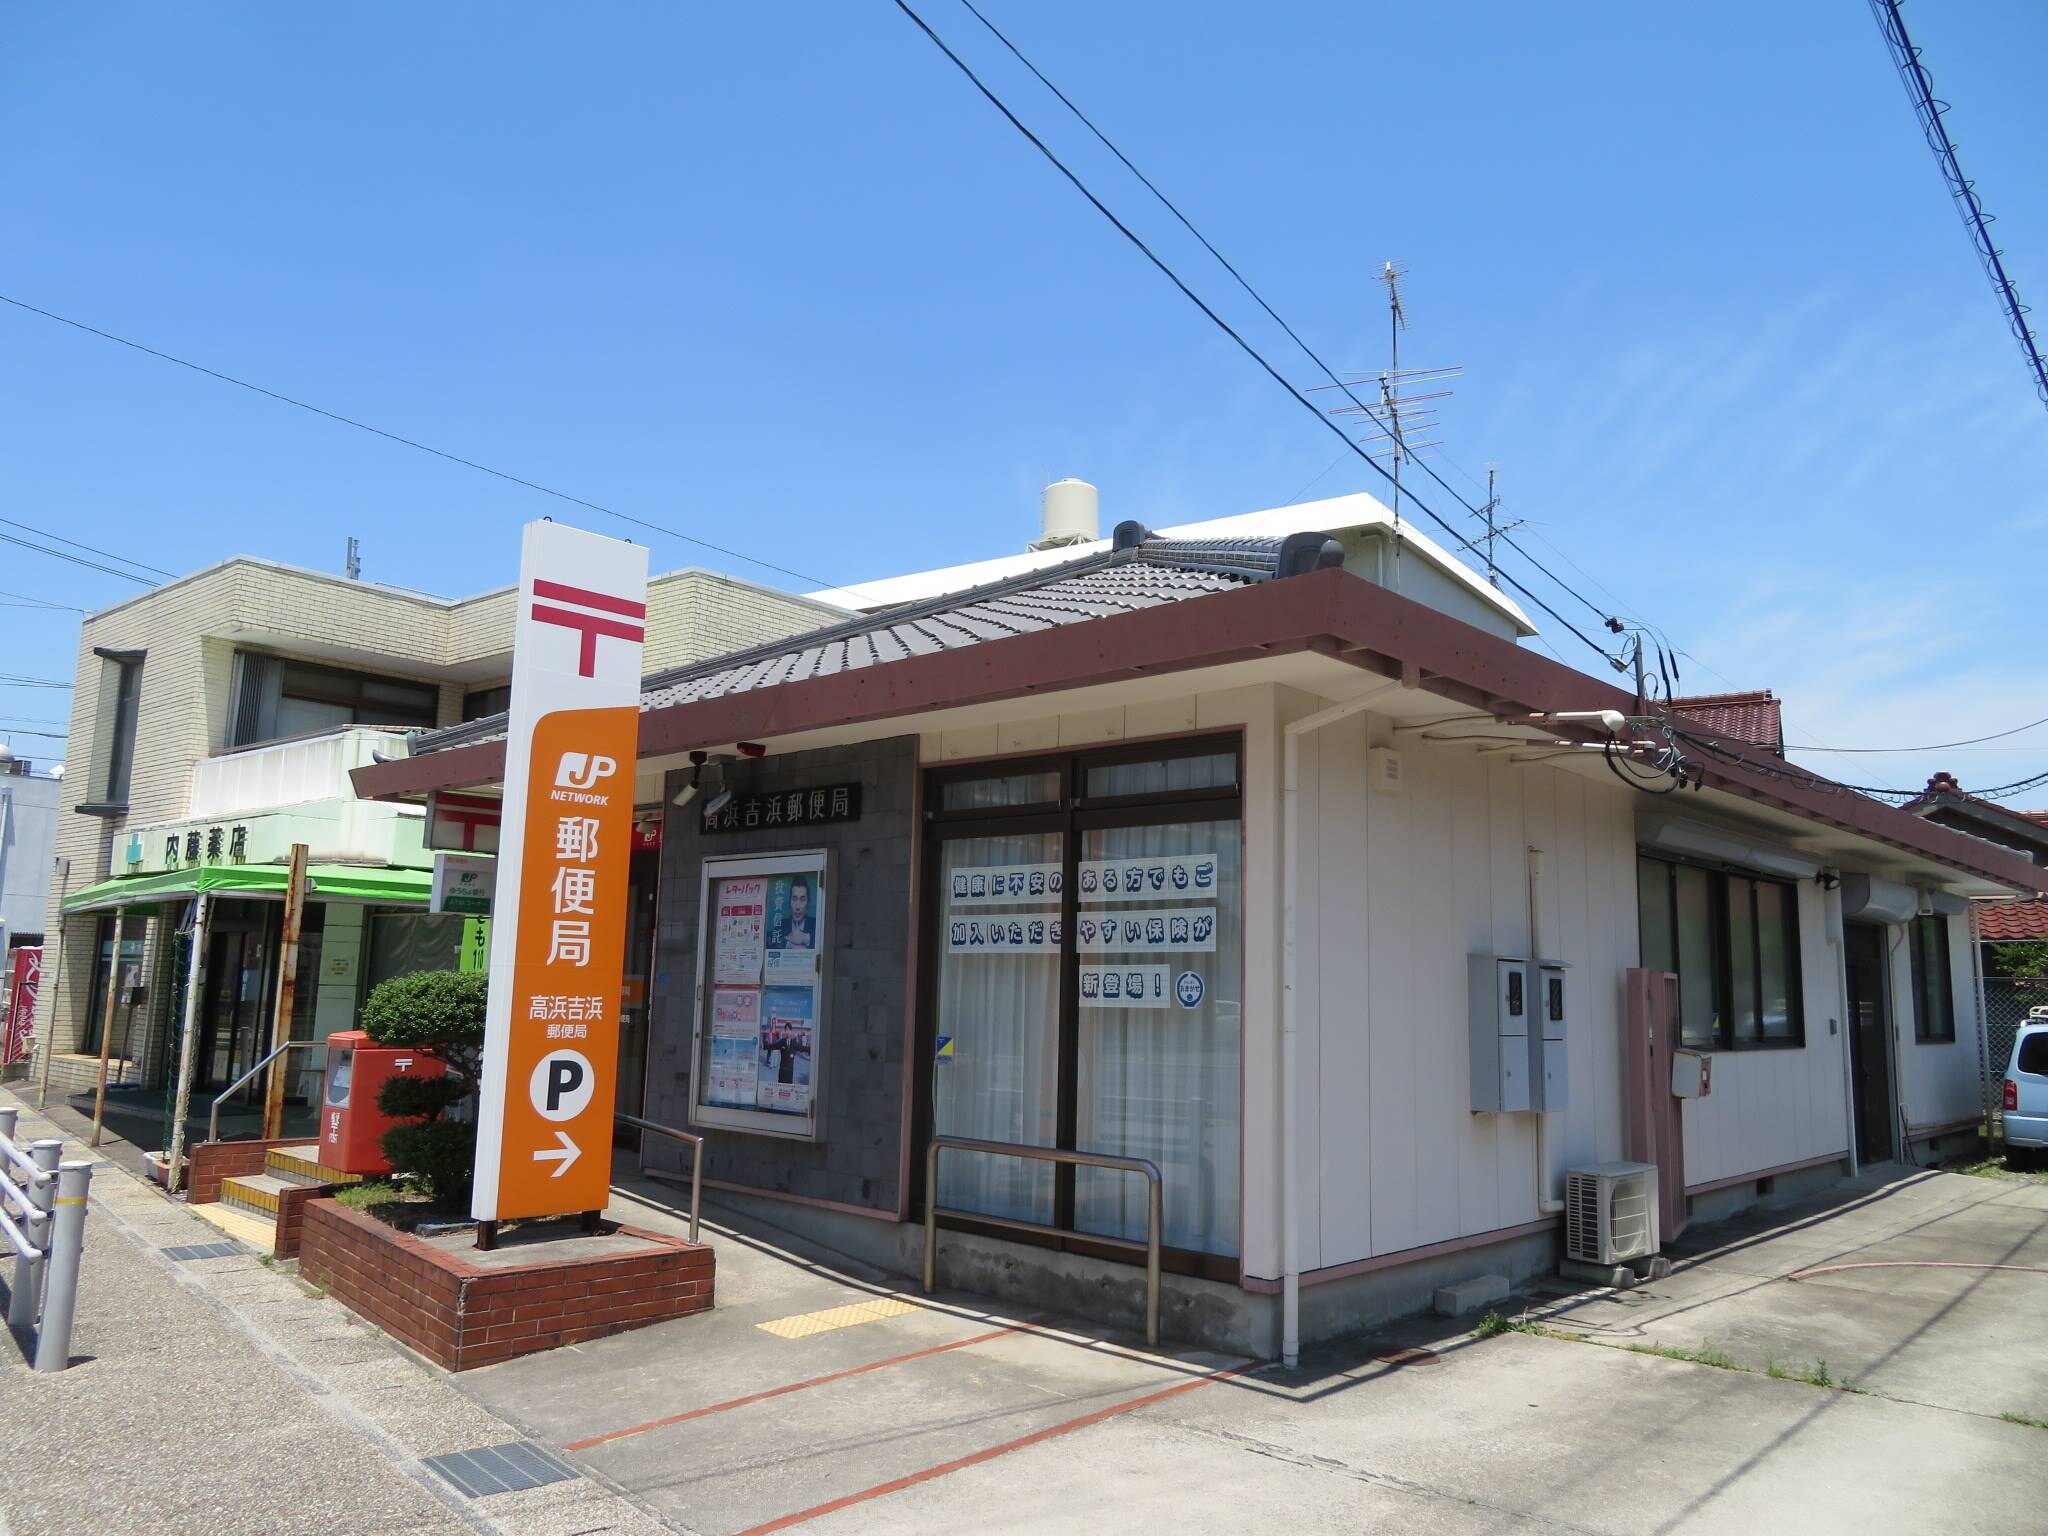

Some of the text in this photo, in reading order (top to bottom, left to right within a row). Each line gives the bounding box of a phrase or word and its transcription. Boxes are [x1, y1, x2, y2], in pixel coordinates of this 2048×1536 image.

[554, 751, 617, 790] JP
[550, 790, 609, 806] NETWORK
[165, 823, 249, 865] 内藤薬店
[546, 816, 600, 967] 郵便局
[953, 861, 1213, 899] 健康に不安の ある方でもご
[951, 915, 1213, 946] 加入いただき やすい保険が
[1082, 972, 1162, 999] 新登場！
[529, 995, 603, 1021] 高浜吉浜
[546, 1023, 588, 1039] 郵便局
[546, 1059, 584, 1111] P
